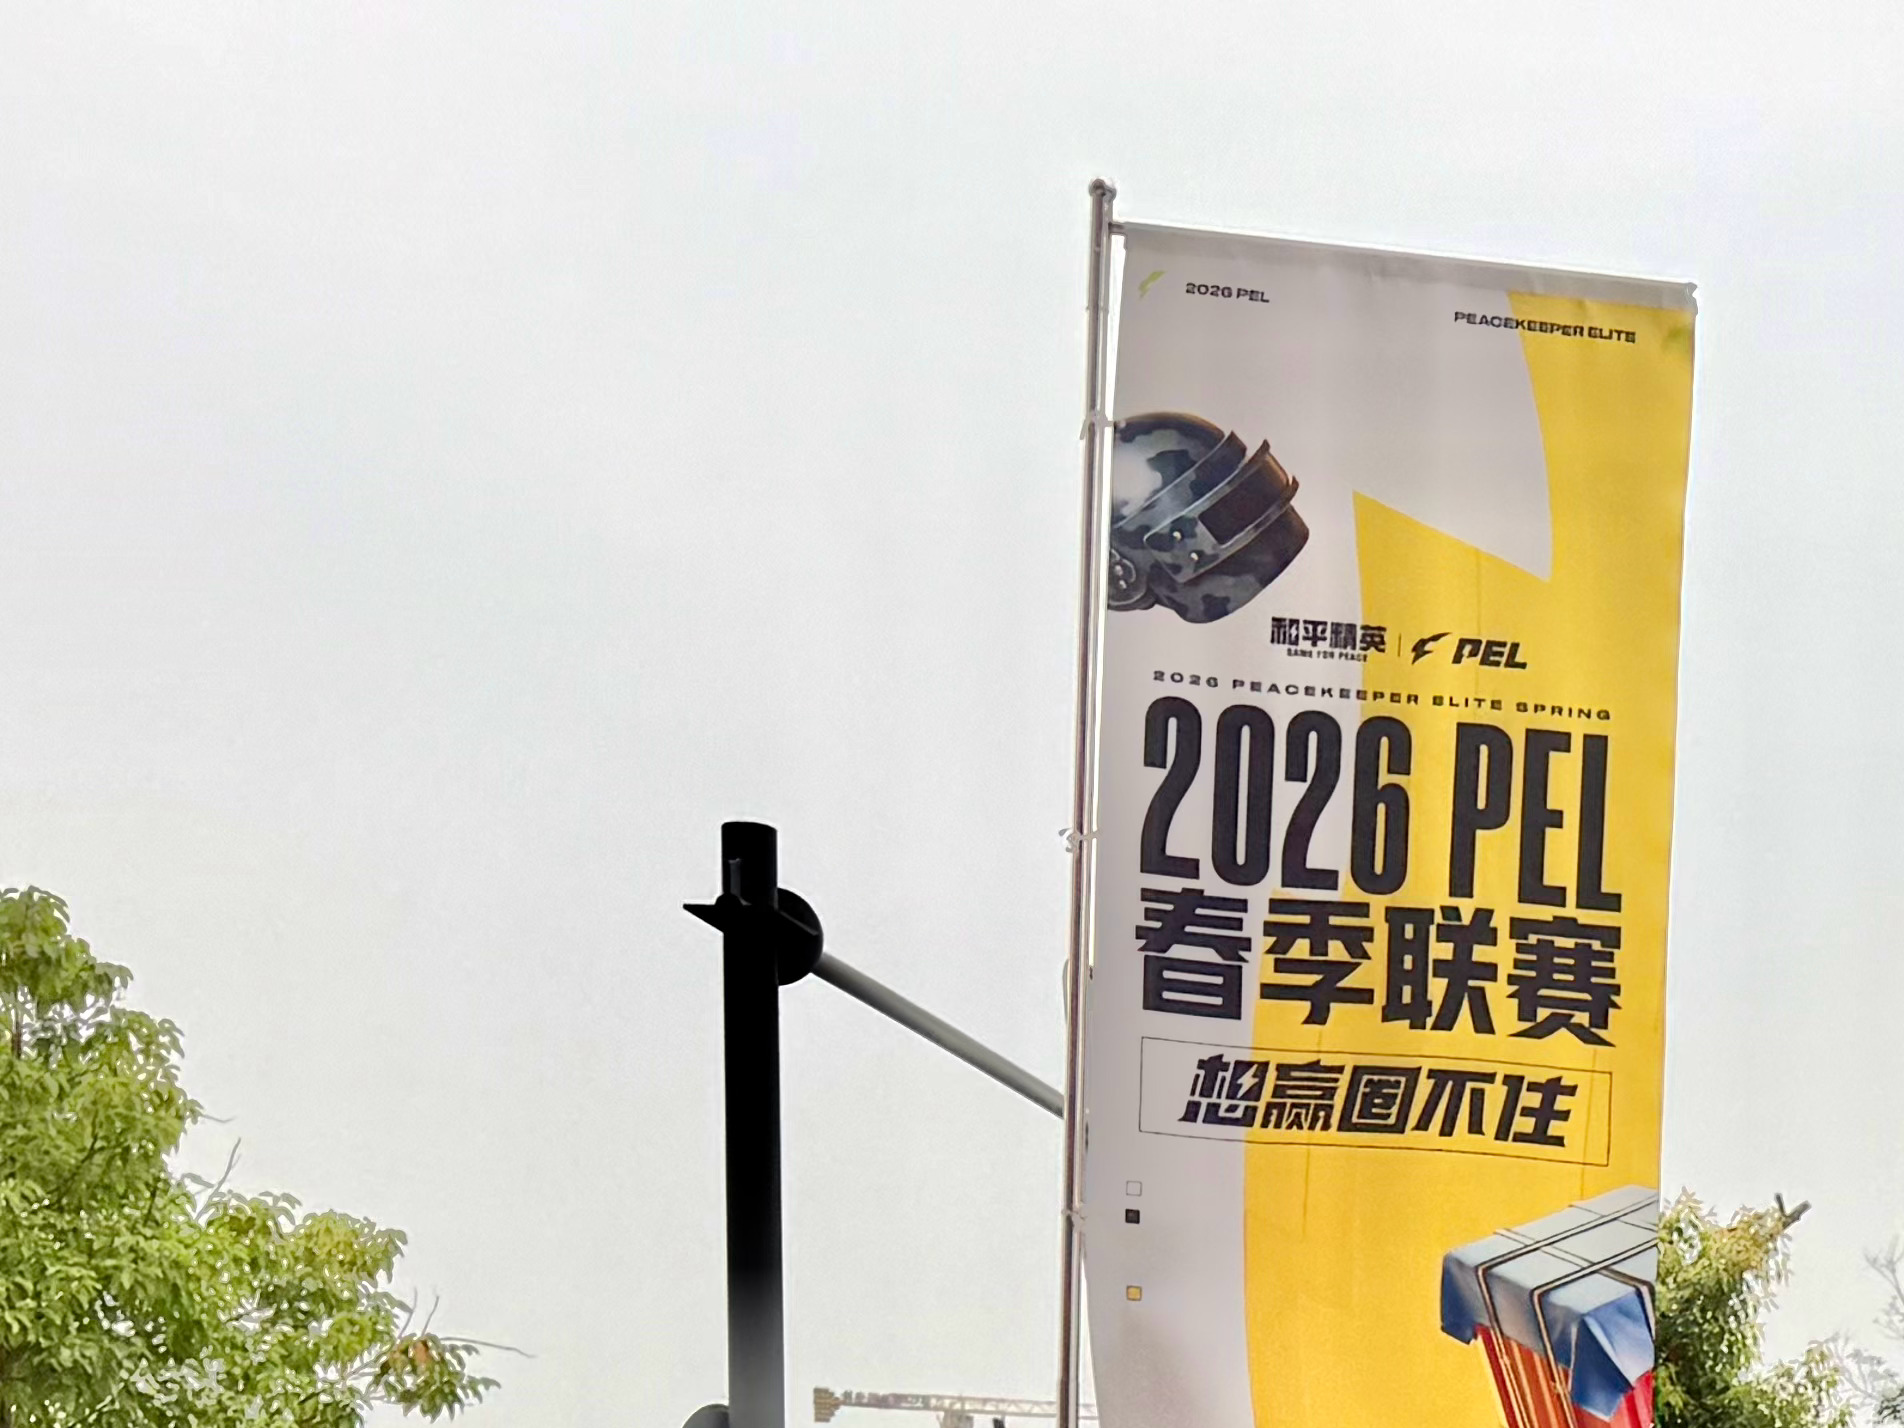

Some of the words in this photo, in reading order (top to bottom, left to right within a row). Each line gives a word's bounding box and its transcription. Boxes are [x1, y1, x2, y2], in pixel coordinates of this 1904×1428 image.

[1185, 282, 1233, 299] 2026
[1236, 288, 1270, 303] PEL
[1453, 310, 1585, 338] PEACEKEEPER
[1588, 326, 1636, 344] ELITE
[1270, 616, 1387, 653] 和平精英
[1451, 637, 1528, 670] PEL
[1152, 669, 1219, 688] 2026
[1232, 678, 1421, 706] PEACEKEEPER
[1432, 695, 1503, 712] ELITE
[1515, 701, 1612, 721] SPRING
[1139, 695, 1413, 896] 2026
[1448, 722, 1622, 914] PEL
[1135, 888, 1623, 1048] 春季联赛
[1176, 1052, 1580, 1148] 想赢圈不住
